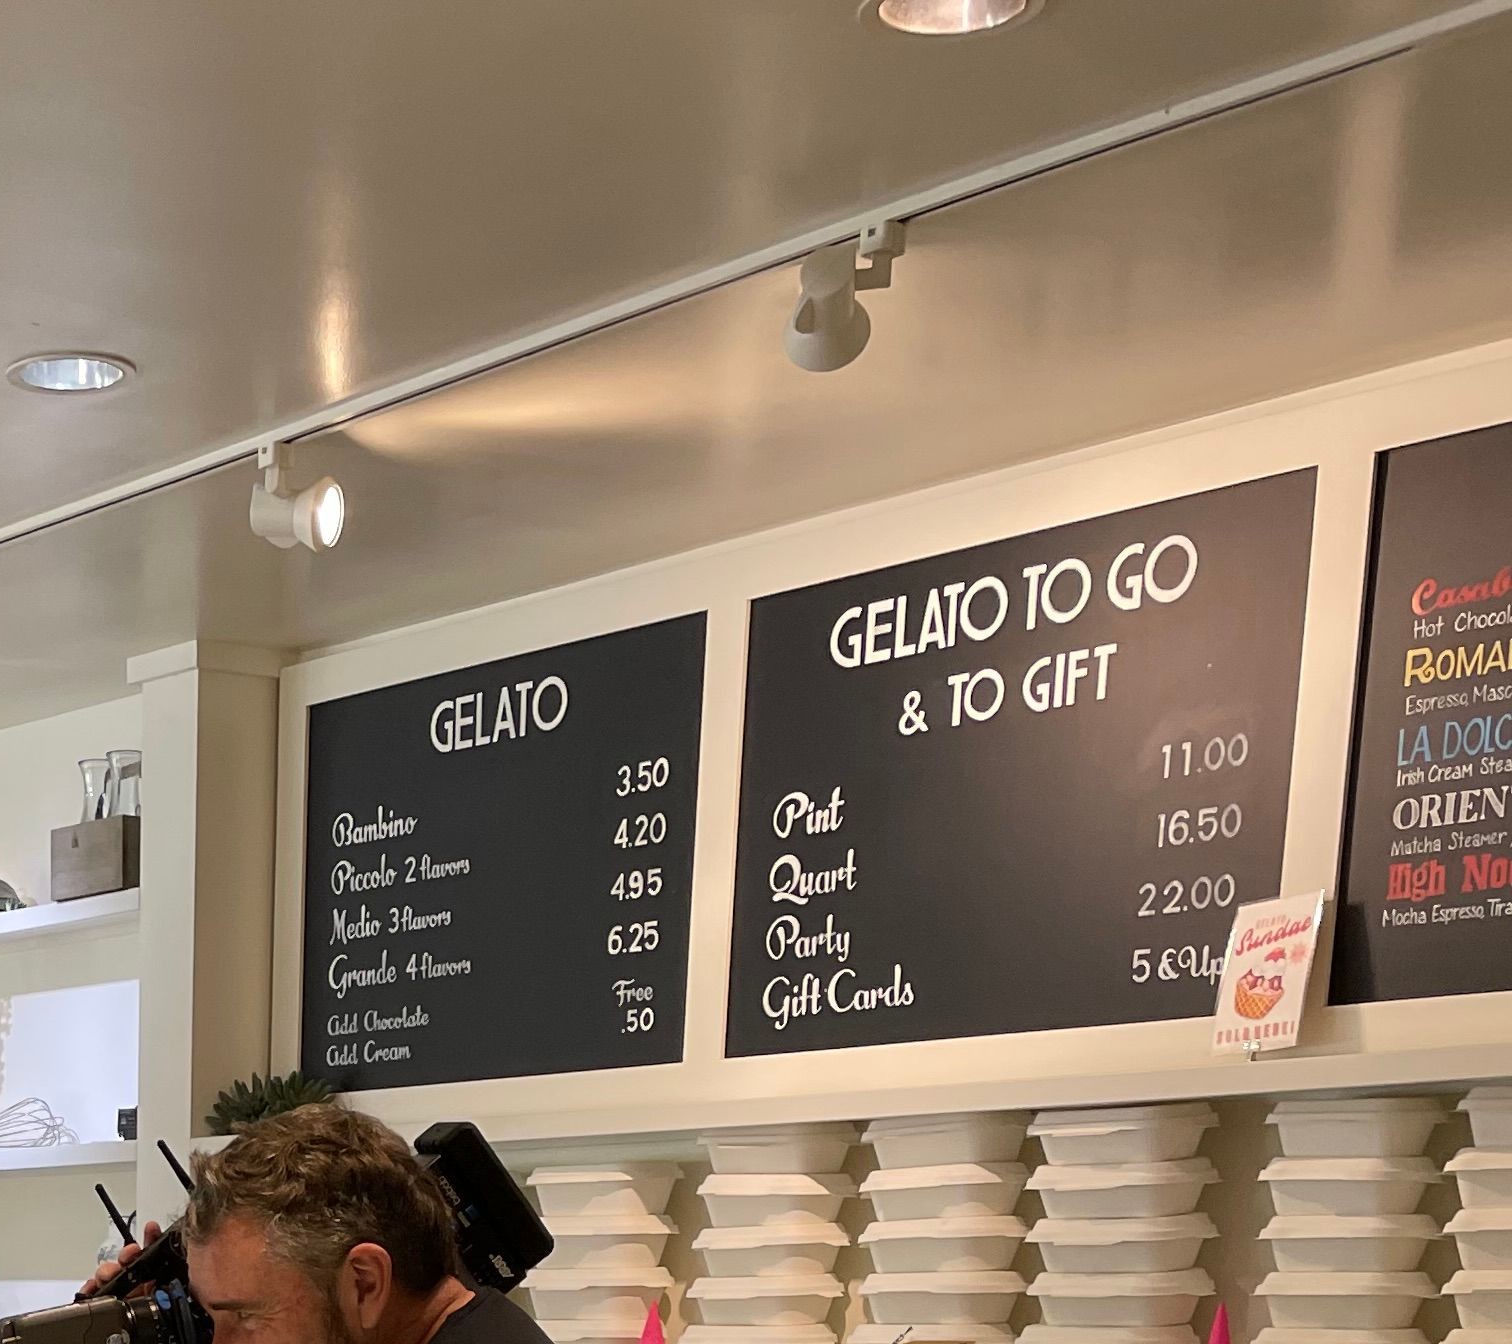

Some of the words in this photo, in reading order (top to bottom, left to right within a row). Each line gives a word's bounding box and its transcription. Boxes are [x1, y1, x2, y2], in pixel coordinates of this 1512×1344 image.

[829, 576, 1008, 668] GELATO
[1023, 558, 1091, 630] TO
[1107, 534, 1198, 611] GO
[1413, 616, 1445, 640] Hot
[1454, 603, 1512, 632] Chocol
[1403, 637, 1512, 688] ROMA
[898, 690, 929, 736] &
[947, 668, 1005, 727] TO
[1022, 643, 1117, 713] GIFT
[430, 676, 569, 753] GELATO
[1161, 733, 1249, 779] 11.00
[1396, 725, 1432, 767] LA
[616, 756, 670, 797] 3.50
[1396, 767, 1425, 787] Irish
[331, 805, 418, 848] Bambino
[772, 786, 845, 839] Pint
[1157, 803, 1242, 848] 16.50
[1392, 785, 1512, 831] ORIEN
[613, 812, 667, 849] 4.20
[1391, 836, 1442, 857] Matcha
[331, 853, 398, 895] Piccolo
[610, 867, 663, 901] 4.95
[768, 849, 857, 906] Quart
[1461, 853, 1512, 893] No
[1138, 874, 1236, 917] 22.00
[329, 904, 382, 946] Medio
[608, 920, 660, 955] 6.25
[765, 913, 851, 963] Party
[1235, 916, 1312, 957] Sundae
[1382, 906, 1427, 928] Mocha
[328, 949, 397, 999] Grande
[1132, 948, 1151, 983] 5
[611, 978, 654, 1007] Free
[762, 973, 822, 1030] Gift
[827, 963, 915, 1013] Cards
[327, 1012, 359, 1036] Add
[363, 1004, 430, 1032] Chocolate
[621, 1007, 655, 1034] .50
[326, 1043, 358, 1067] Add
[363, 1039, 412, 1063] Cream
